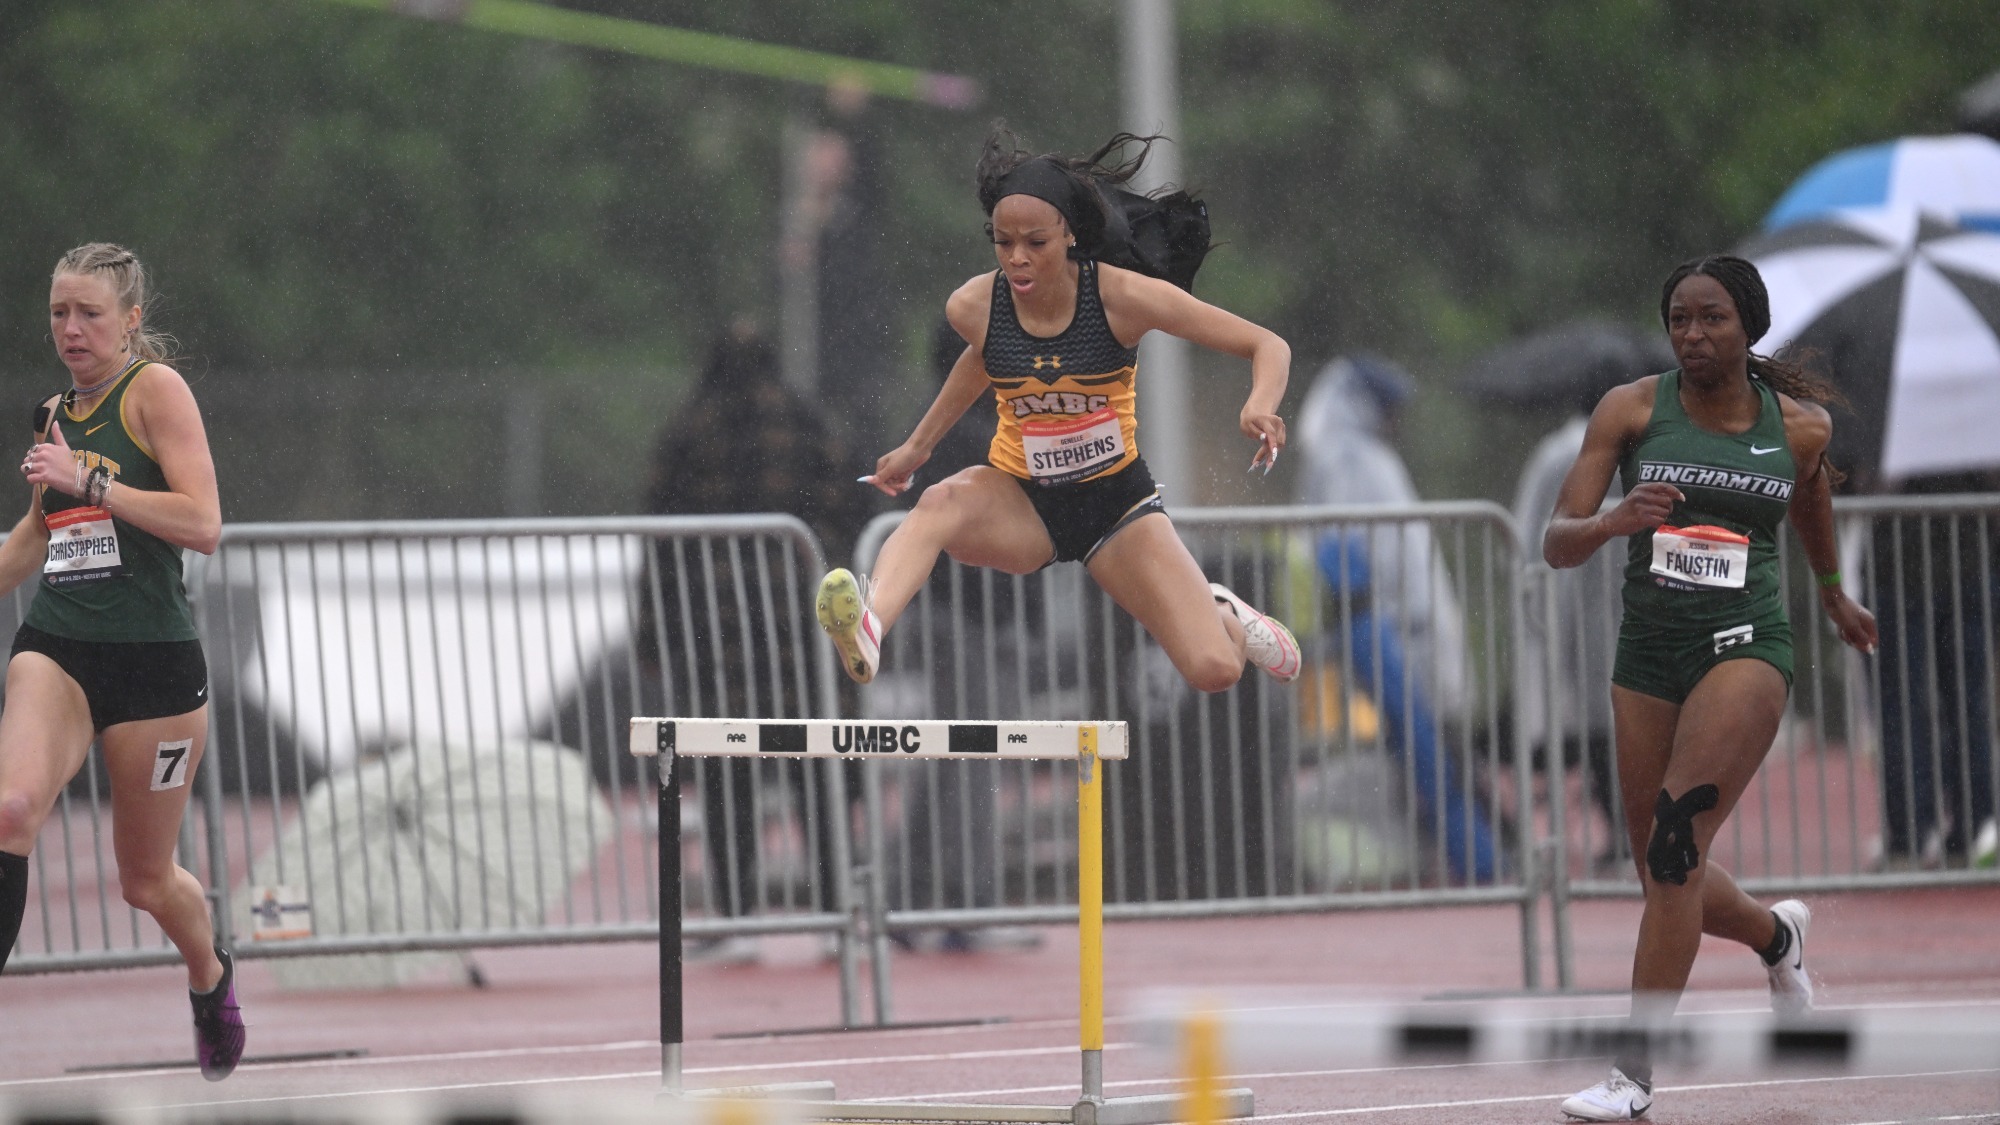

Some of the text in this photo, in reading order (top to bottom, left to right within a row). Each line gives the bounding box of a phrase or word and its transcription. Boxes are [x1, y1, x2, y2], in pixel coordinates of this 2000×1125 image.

[1033, 435, 1115, 470] STEPHENS
[1060, 435, 1083, 445] GENELLE
[1640, 464, 1793, 500] BINGHAMTON
[50, 535, 116, 562] CHRISTOPHER
[1666, 551, 1731, 579] FAUSTIN
[832, 725, 921, 753] UMBC
[159, 746, 187, 784] 7
